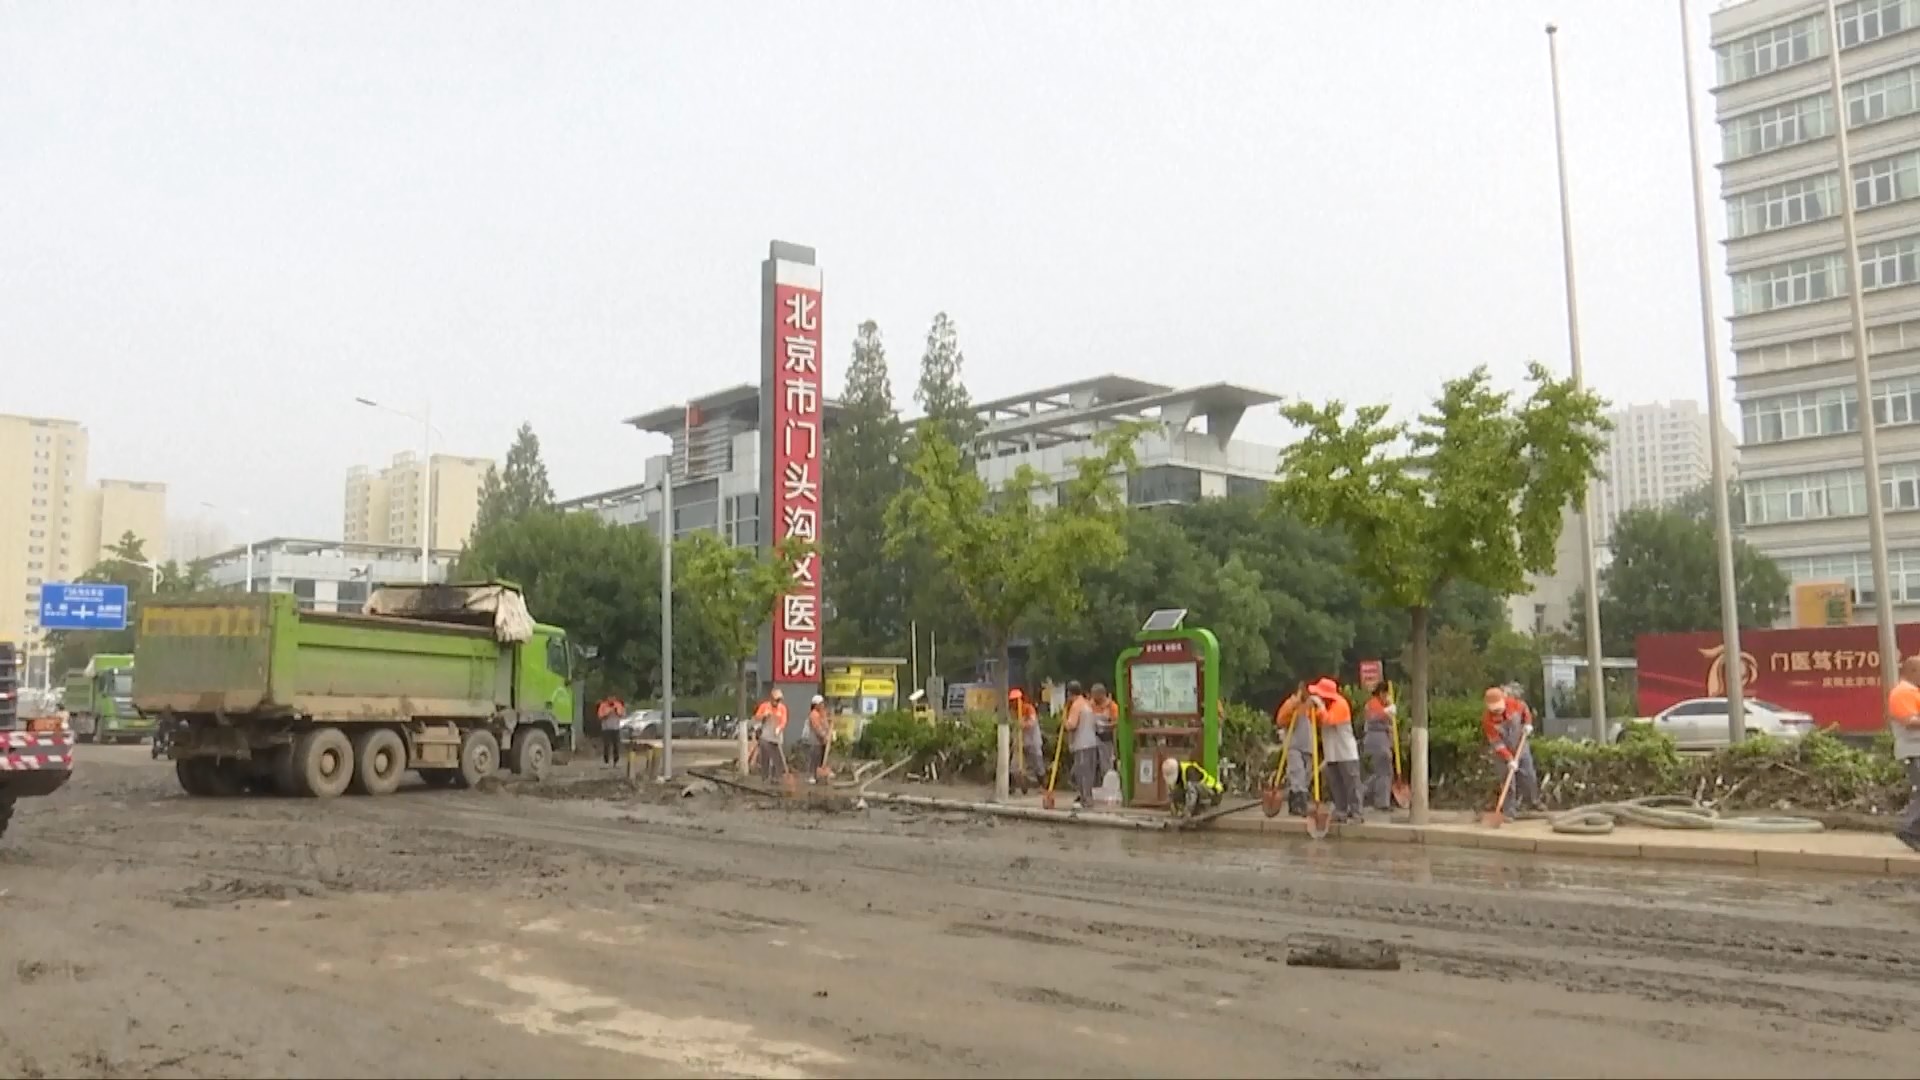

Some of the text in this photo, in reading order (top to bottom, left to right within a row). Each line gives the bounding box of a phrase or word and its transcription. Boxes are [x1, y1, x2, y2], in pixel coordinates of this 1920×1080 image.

[784, 292, 817, 677] 北京市门头沟区医院
